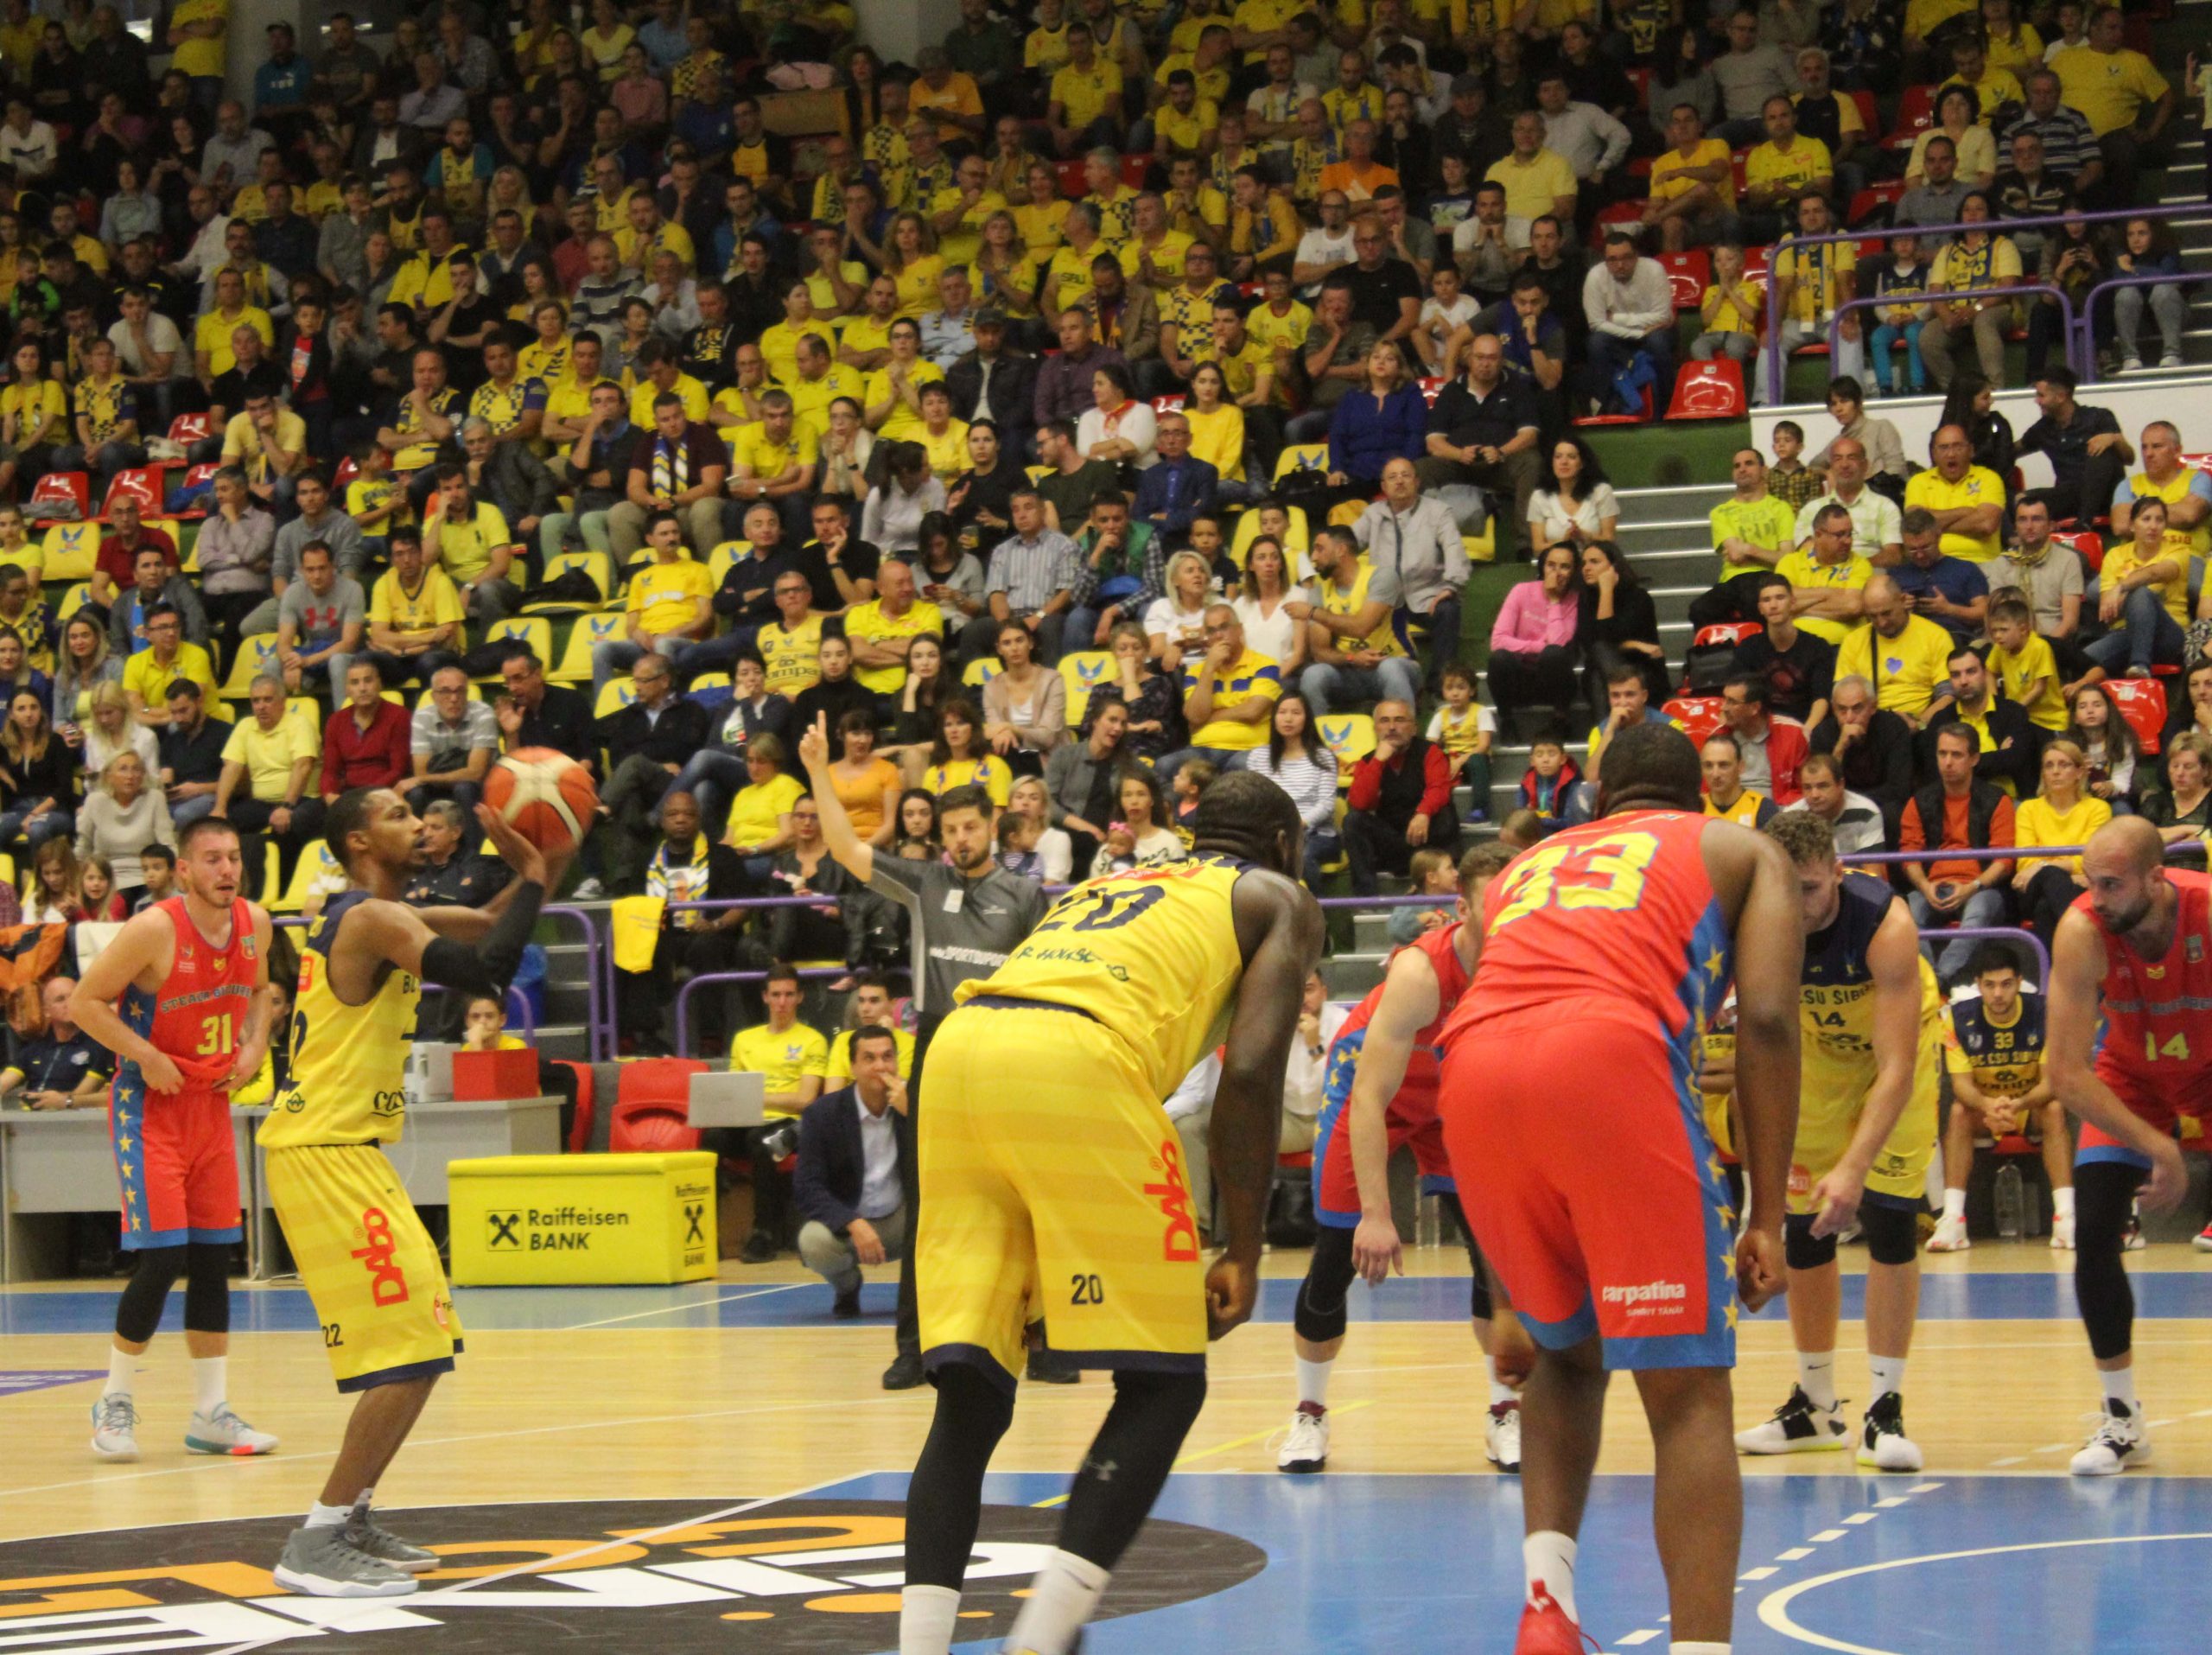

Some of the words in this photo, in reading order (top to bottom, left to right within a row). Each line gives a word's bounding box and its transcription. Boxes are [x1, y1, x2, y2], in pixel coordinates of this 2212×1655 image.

[1488, 831, 1660, 936] 33
[1800, 989, 1826, 1005] SU
[1808, 1011, 1847, 1028] 14
[196, 1013, 232, 1055] 31
[1993, 1031, 2015, 1049] 33
[2145, 1031, 2190, 1061] 14
[528, 1207, 630, 1227] Raiffeisen
[530, 1232, 591, 1251] BANK
[1071, 1274, 1104, 1306] 20
[321, 1323, 345, 1349] 22
